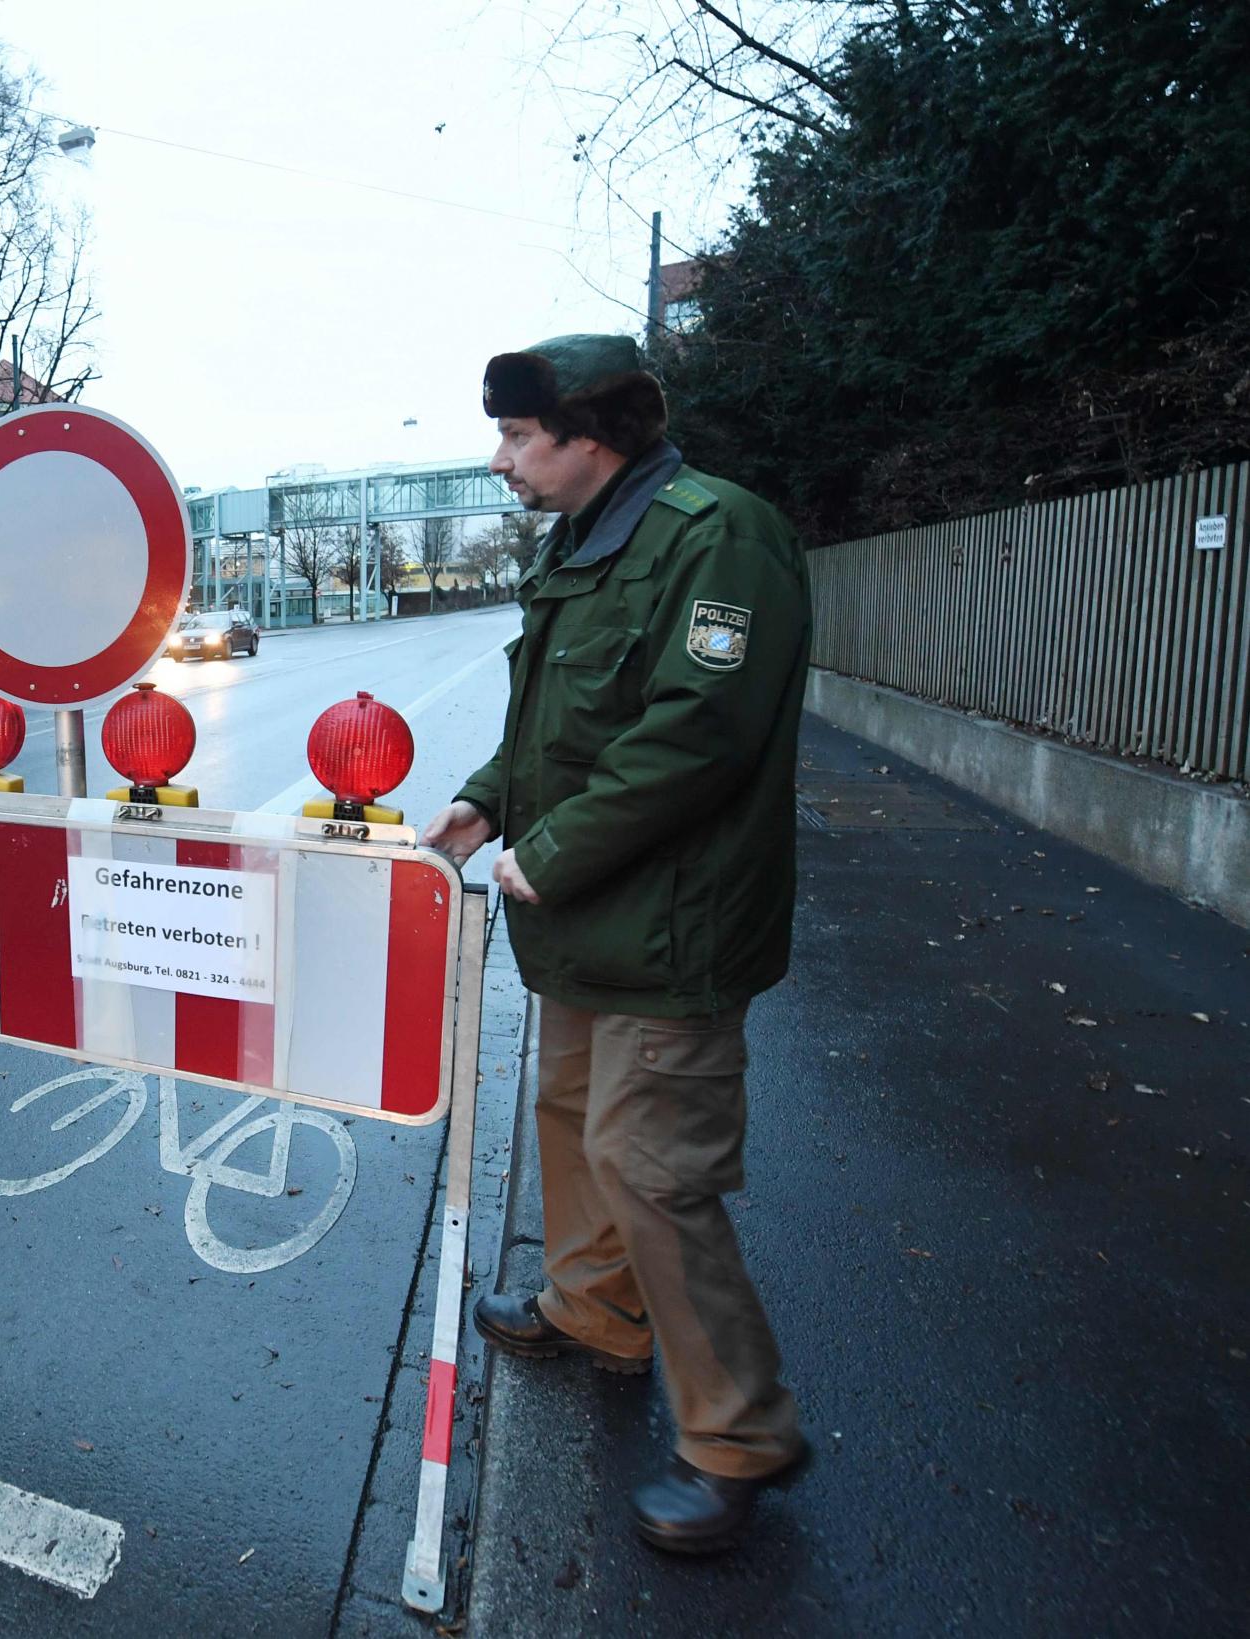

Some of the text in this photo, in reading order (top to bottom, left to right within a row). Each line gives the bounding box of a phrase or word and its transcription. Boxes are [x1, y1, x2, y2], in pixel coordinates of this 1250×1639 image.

[697, 607, 746, 627] POLIZEI
[95, 867, 243, 899] Gefahrenzone
[162, 927, 247, 949] verboten
[104, 957, 152, 975] Augsburg,
[155, 965, 173, 977] Tel.
[176, 968, 201, 981] 0821
[210, 973, 230, 985] 324
